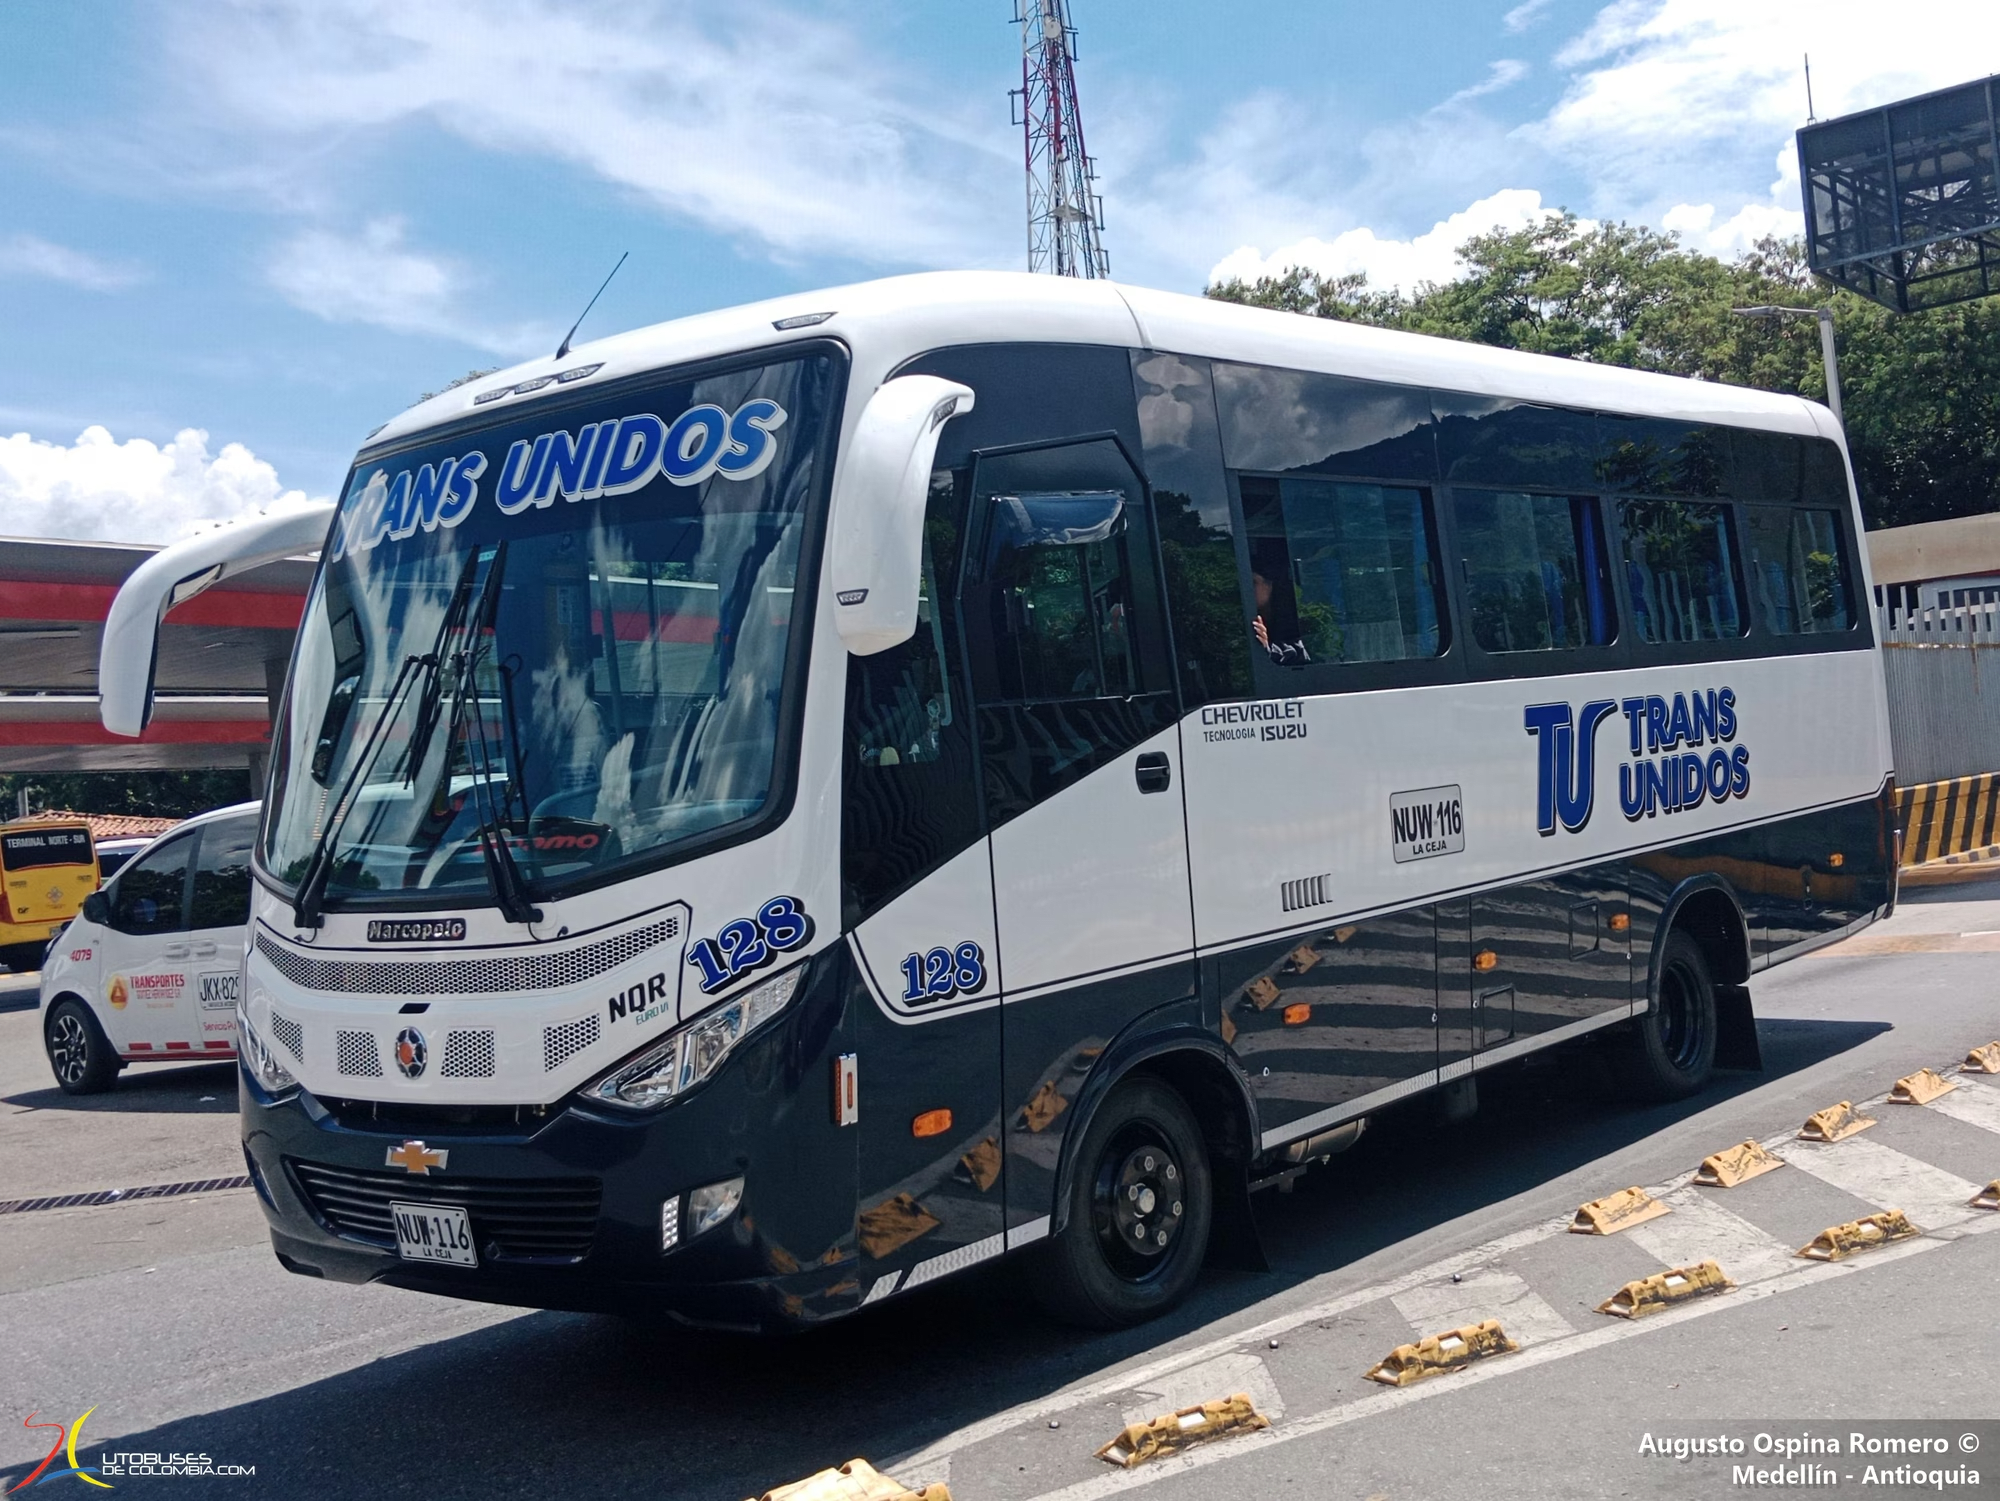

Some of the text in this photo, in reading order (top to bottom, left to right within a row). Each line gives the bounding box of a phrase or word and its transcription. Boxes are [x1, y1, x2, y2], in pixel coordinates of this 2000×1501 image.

[496, 398, 788, 515] UNIDOS
[1201, 701, 1304, 725] CHEVROLET
[1622, 686, 1738, 756] TRANS
[1203, 723, 1307, 743] TECNOLOGIA ISUZU
[1619, 743, 1750, 823] UNIDOS
[7, 836, 46, 848] TERMINAL
[1412, 839, 1447, 855] LA CEJA
[368, 919, 465, 940] Marcopolo
[70, 948, 92, 962] 4079
[686, 895, 816, 995] 128
[130, 974, 185, 989] TRANSPORTES
[901, 940, 988, 1007] 128
[608, 972, 667, 1024] NQR
[422, 1247, 452, 1260] LA CEJA
